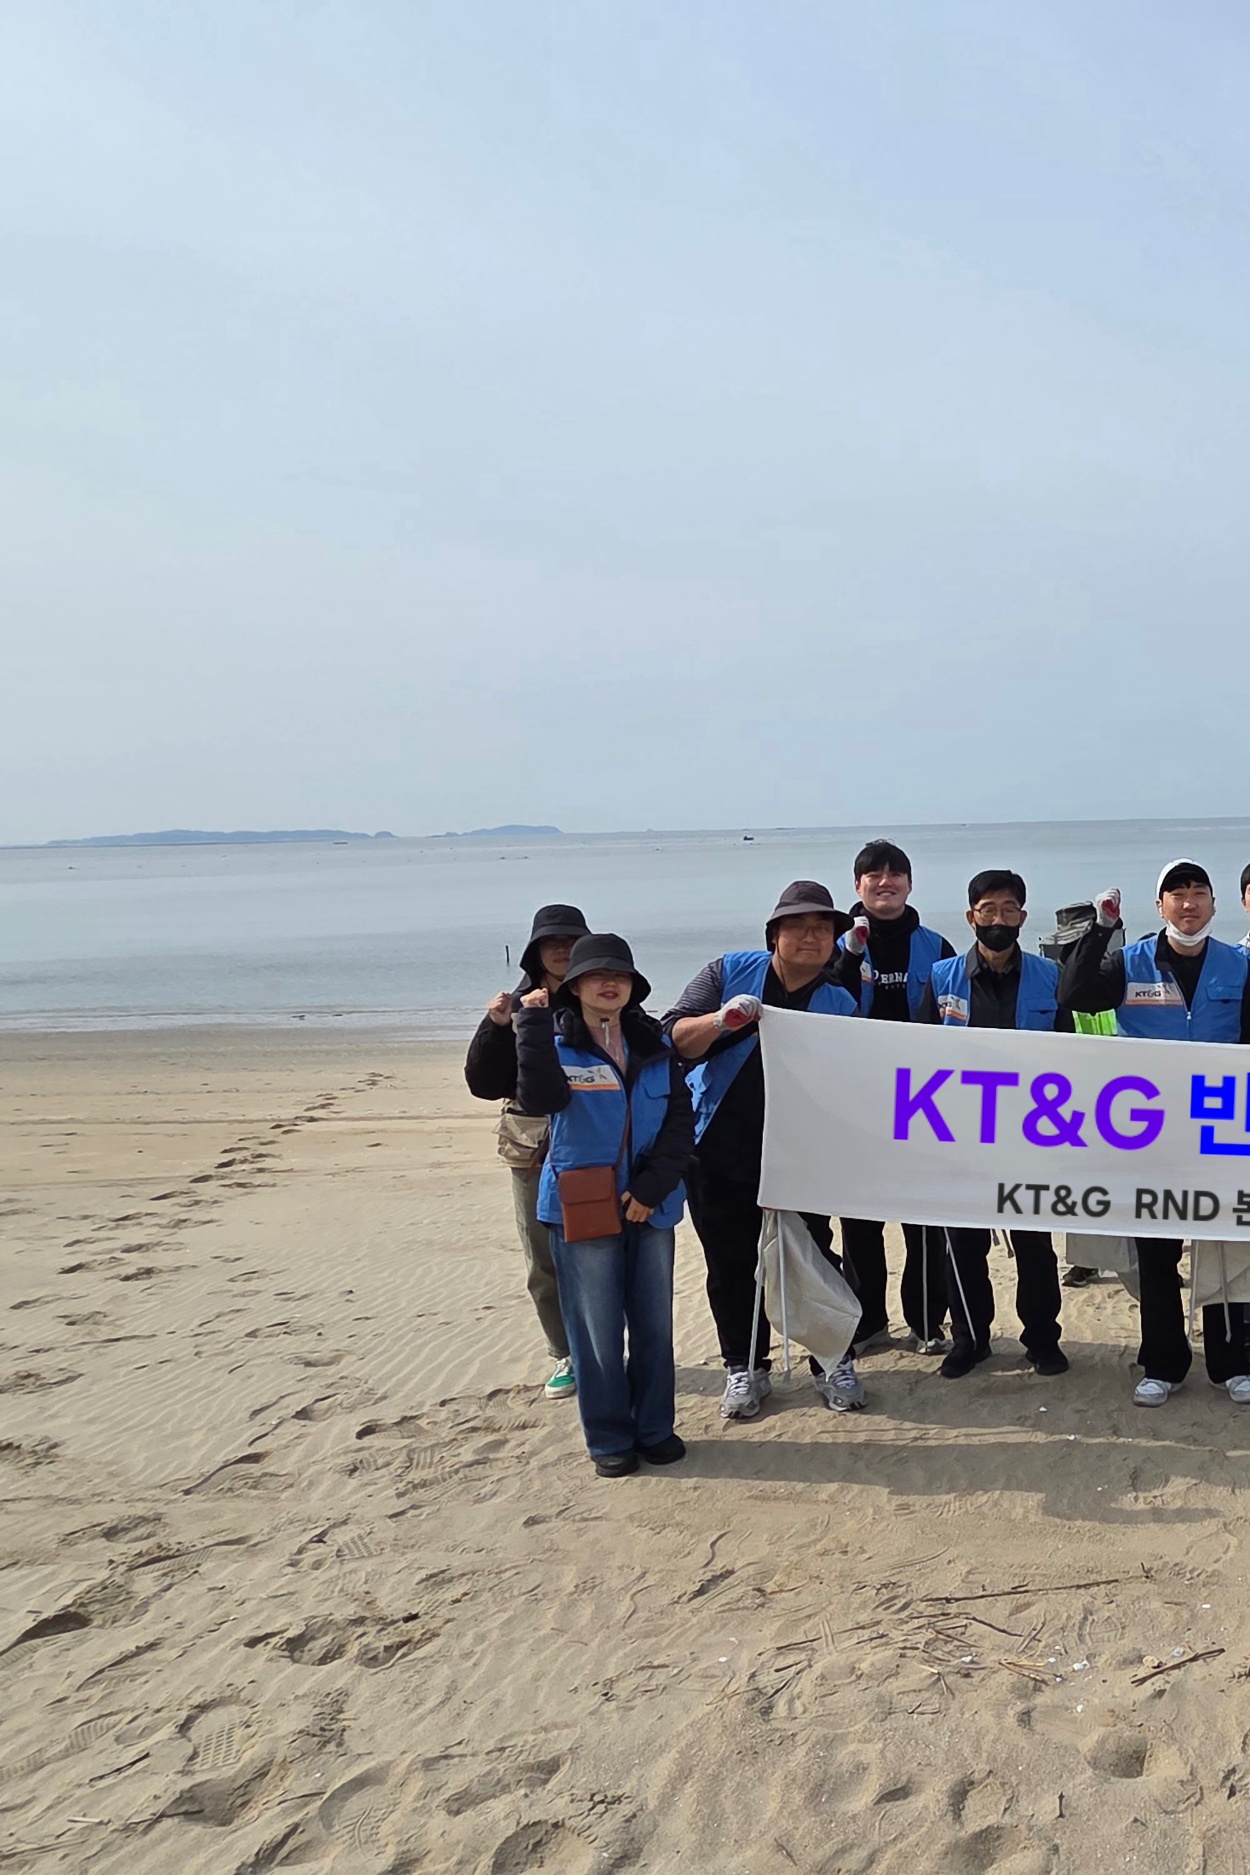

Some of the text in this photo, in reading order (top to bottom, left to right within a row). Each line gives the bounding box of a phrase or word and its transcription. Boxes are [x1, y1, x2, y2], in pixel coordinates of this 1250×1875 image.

[1135, 990, 1162, 998] KT&G
[894, 1068, 1165, 1150] KT&G
[997, 1183, 1111, 1218] KT&G
[1135, 1188, 1221, 1221] RND
